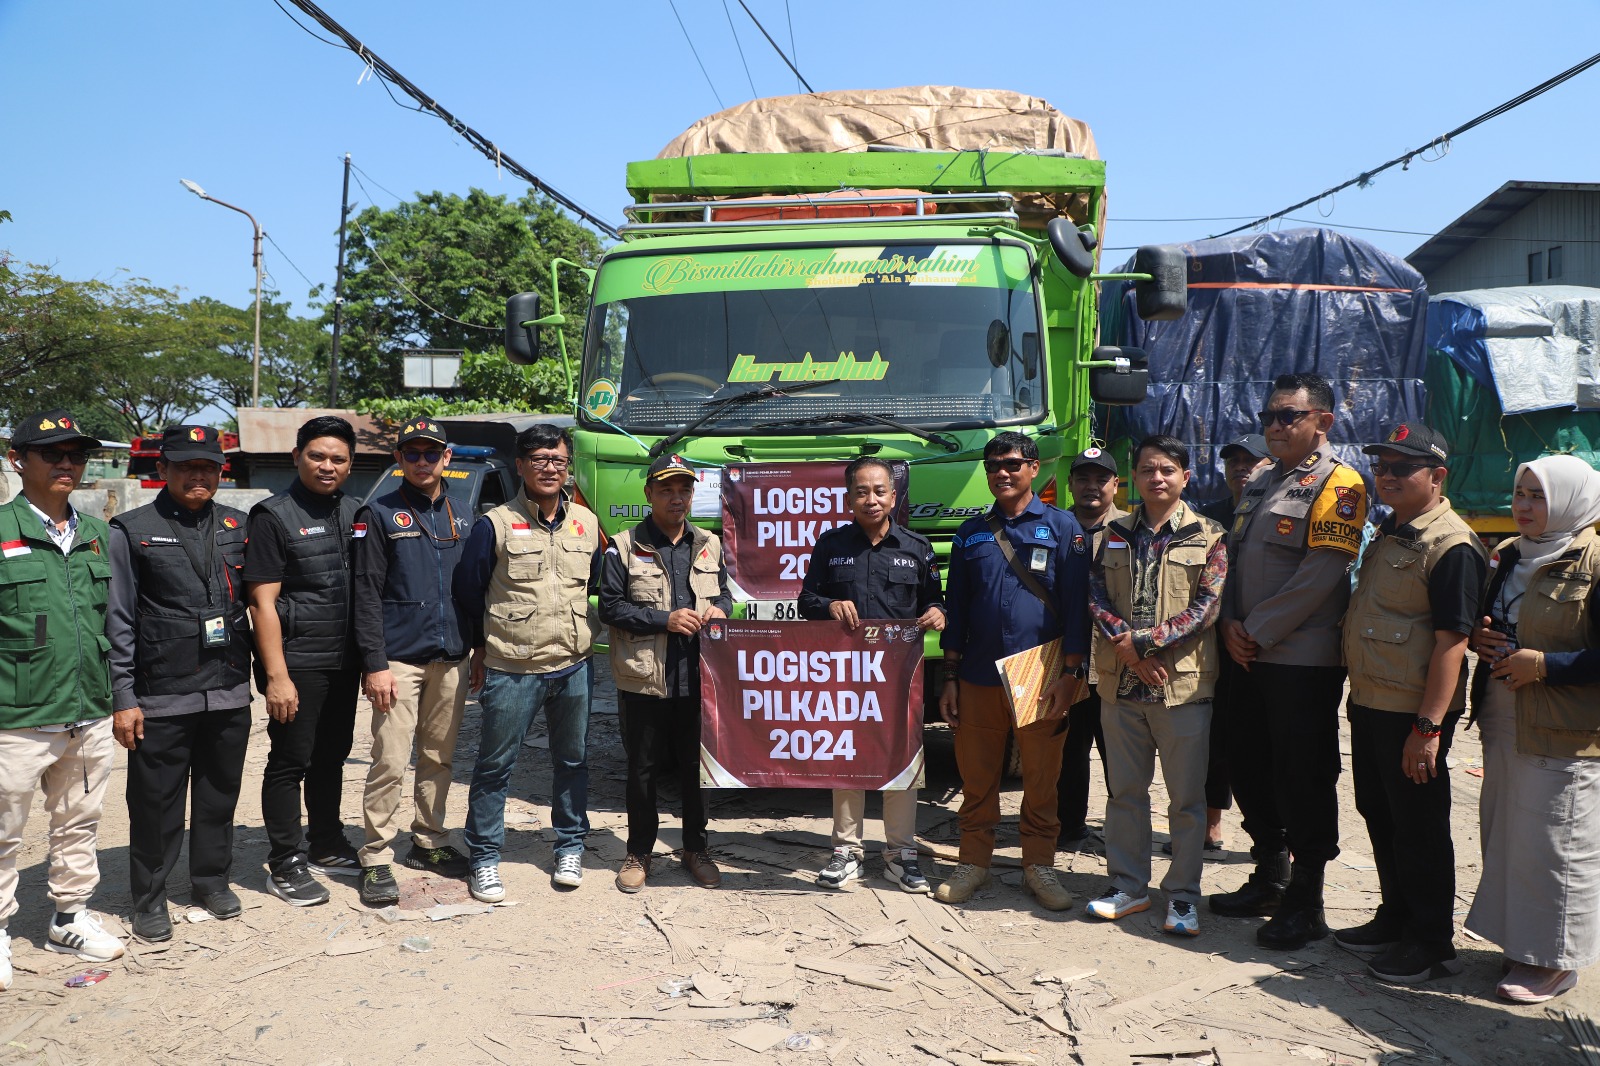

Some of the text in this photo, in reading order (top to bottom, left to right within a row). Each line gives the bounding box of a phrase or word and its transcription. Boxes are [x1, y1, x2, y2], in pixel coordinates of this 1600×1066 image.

[642, 250, 980, 293] Bismillahirrahmanirrahim
[905, 274, 977, 284] Muhammad
[449, 471, 470, 479] BARAT
[754, 487, 853, 515] LOGIST
[1284, 487, 1315, 498] POLRI
[1340, 489, 1357, 498] POLDA
[779, 553, 812, 580] 20
[893, 558, 915, 568] KPU
[747, 602, 804, 620] W 86
[865, 626, 880, 638] 27
[737, 650, 887, 683] LOGISTIK
[742, 689, 884, 722] PILKADA
[769, 729, 857, 761] 2024
